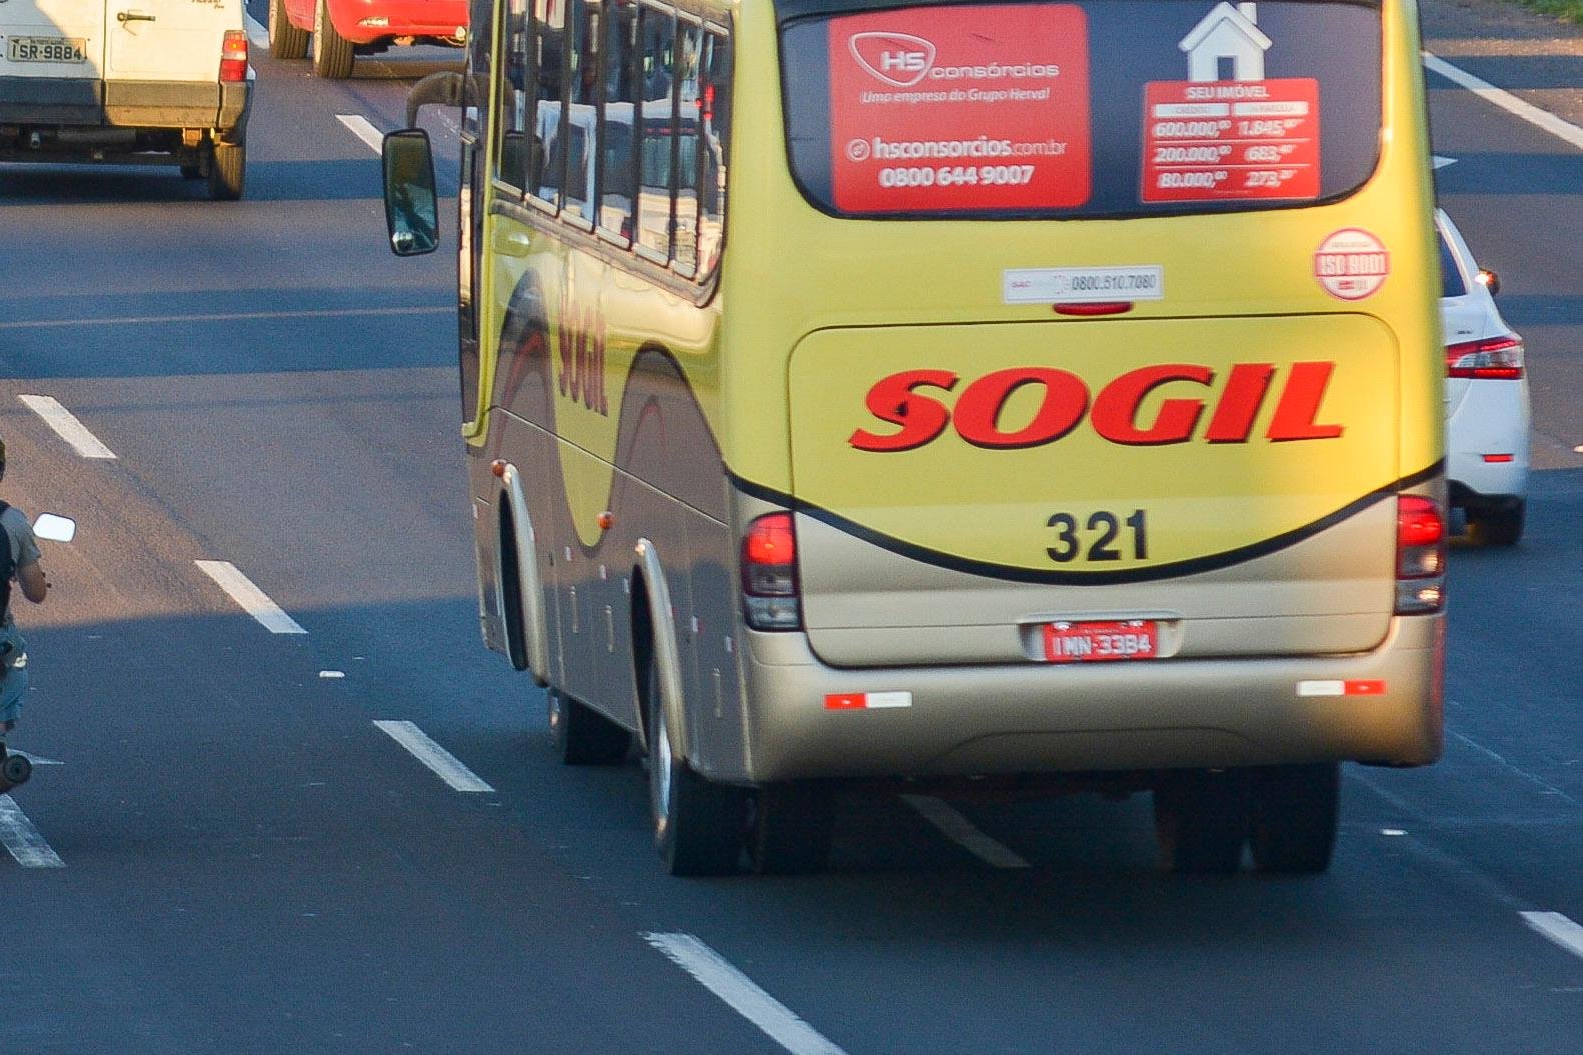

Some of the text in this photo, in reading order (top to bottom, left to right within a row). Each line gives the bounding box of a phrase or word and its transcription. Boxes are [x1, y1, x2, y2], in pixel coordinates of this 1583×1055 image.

[880, 50, 1061, 79] HS consórcios
[861, 90, 892, 103] Uma
[894, 91, 949, 104] empresa
[968, 88, 1009, 103] Grupo
[1009, 87, 1051, 100] Herval
[1186, 86, 1216, 99] SEU
[872, 135, 1068, 159] hsconsorcios.com.br
[878, 164, 1036, 188] 0800 644 9007
[1320, 253, 1346, 276] ISO
[848, 360, 1345, 453] SOGIL
[1045, 509, 1150, 563] 321
